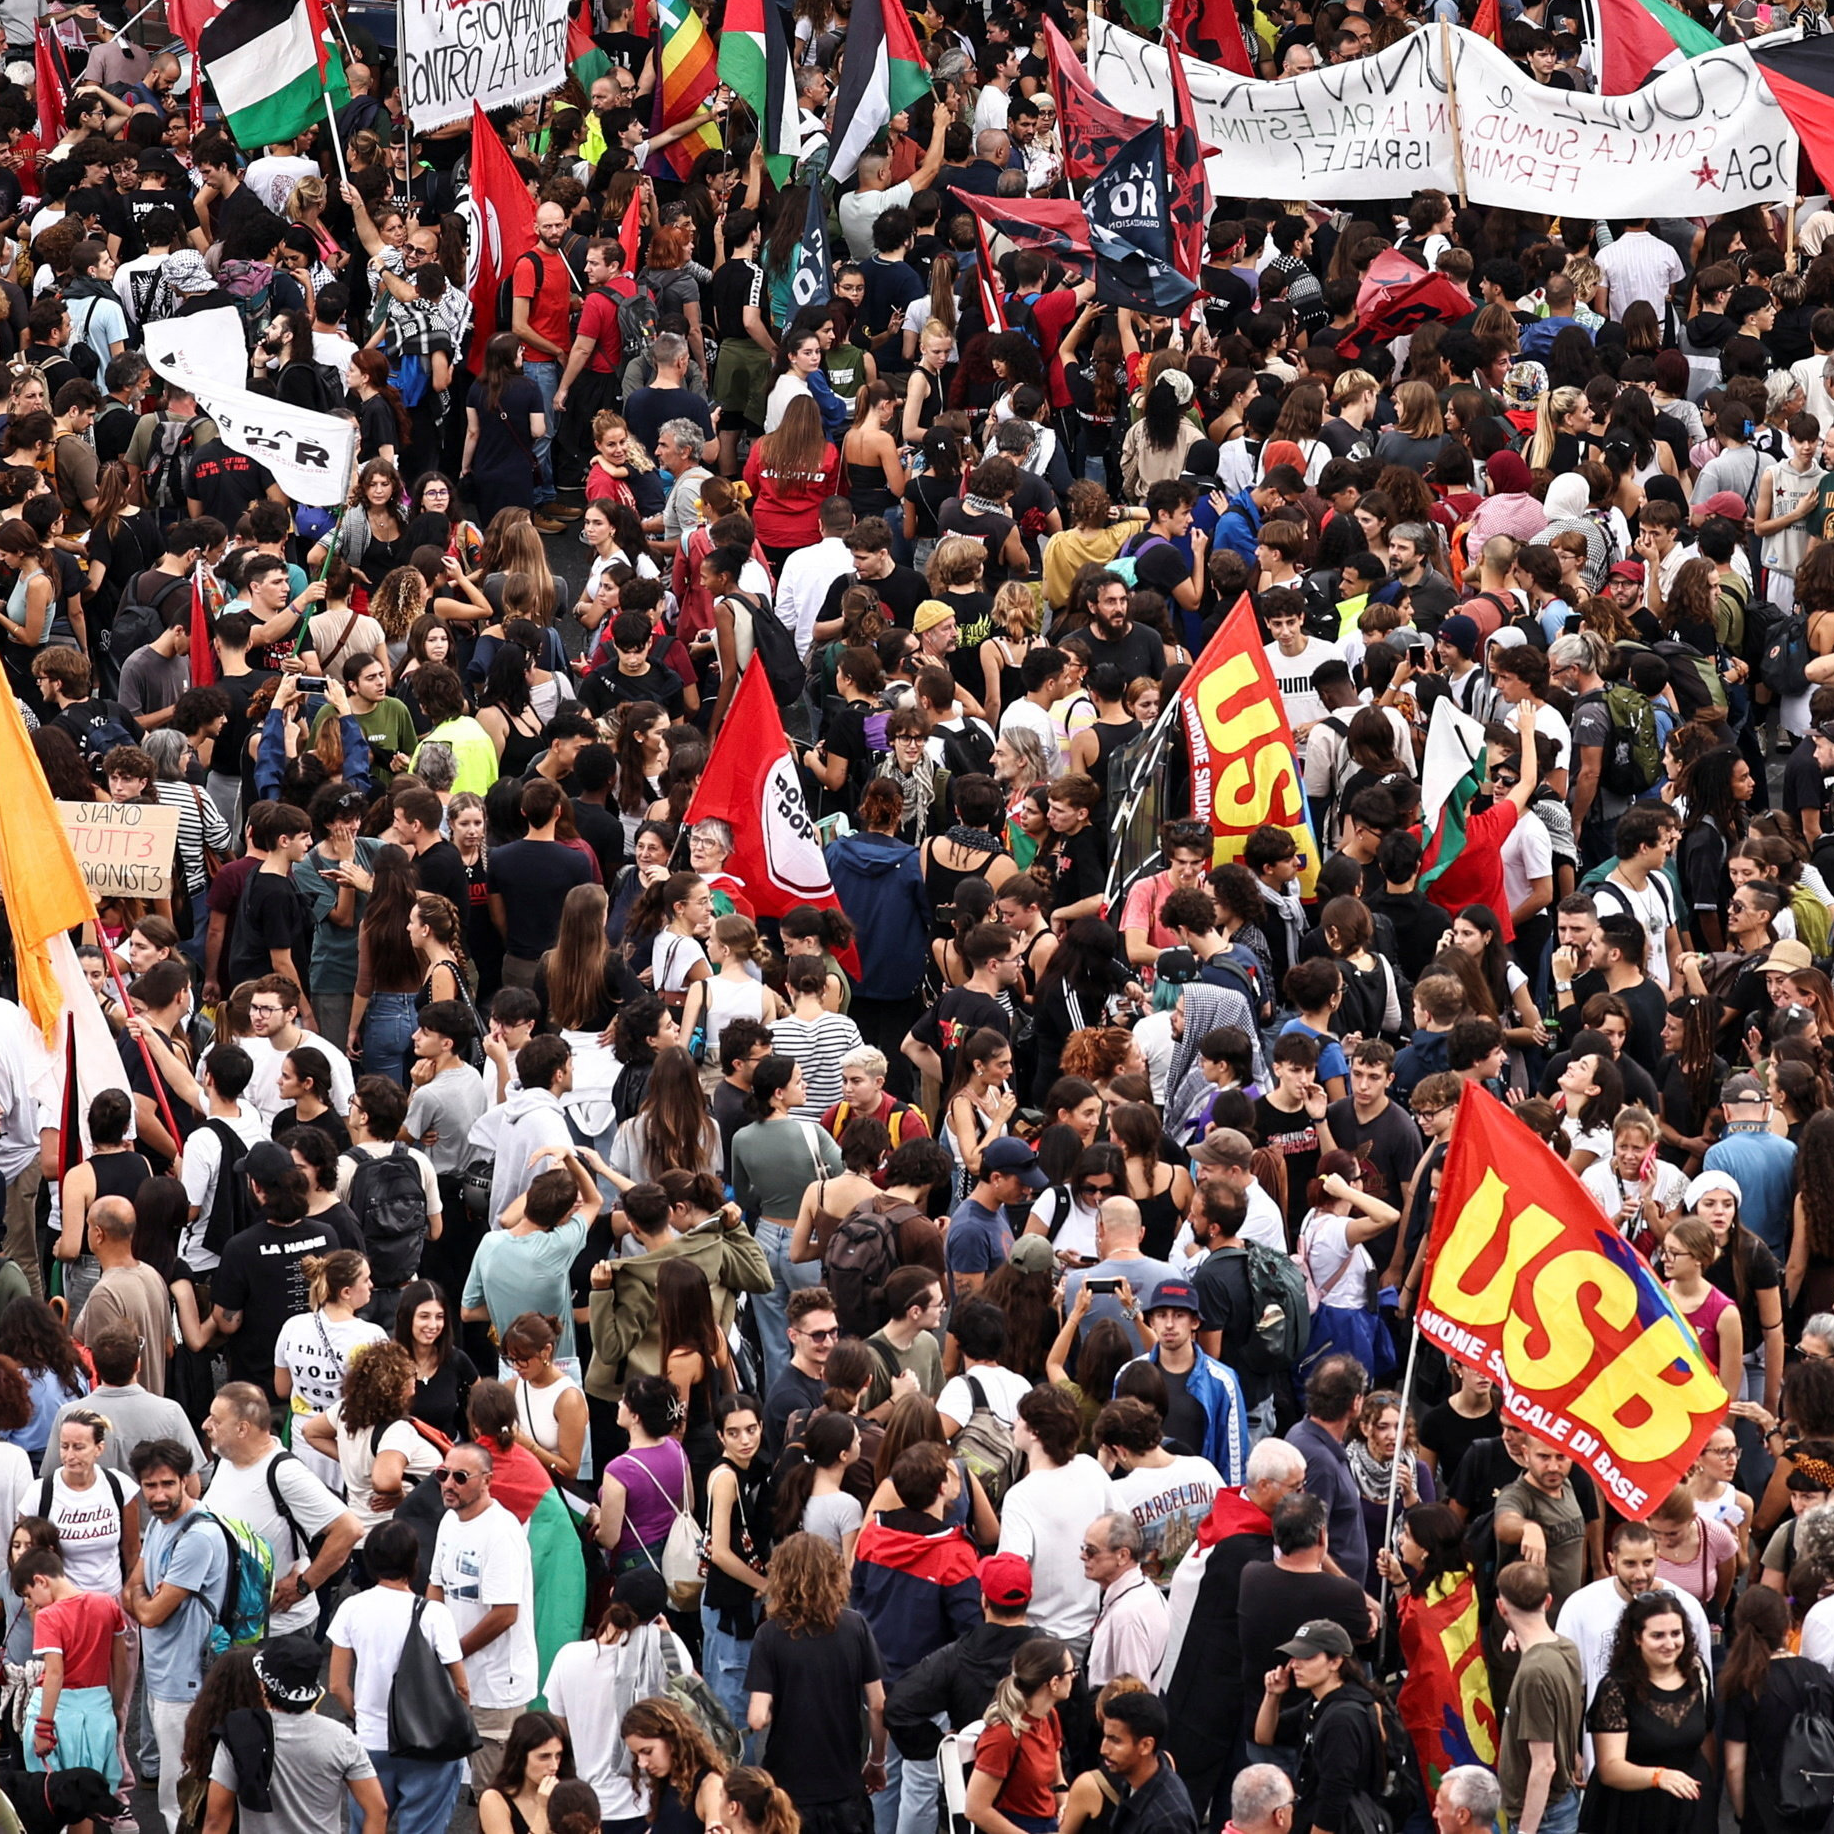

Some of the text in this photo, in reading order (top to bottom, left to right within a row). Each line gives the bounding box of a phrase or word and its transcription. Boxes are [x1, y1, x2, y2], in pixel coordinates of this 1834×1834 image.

[406, 39, 519, 109] CONTRO LA
[1182, 695, 1210, 766] UNIONE
[76, 800, 145, 827] SIAMO
[67, 825, 155, 858] TUTT3
[259, 1244, 283, 1257] LA
[1427, 1164, 1730, 1465] USB
[1568, 1427, 1650, 1513] DI BASE
[56, 1505, 114, 1525] Intanto
[1129, 1479, 1216, 1528] BARCELONA
